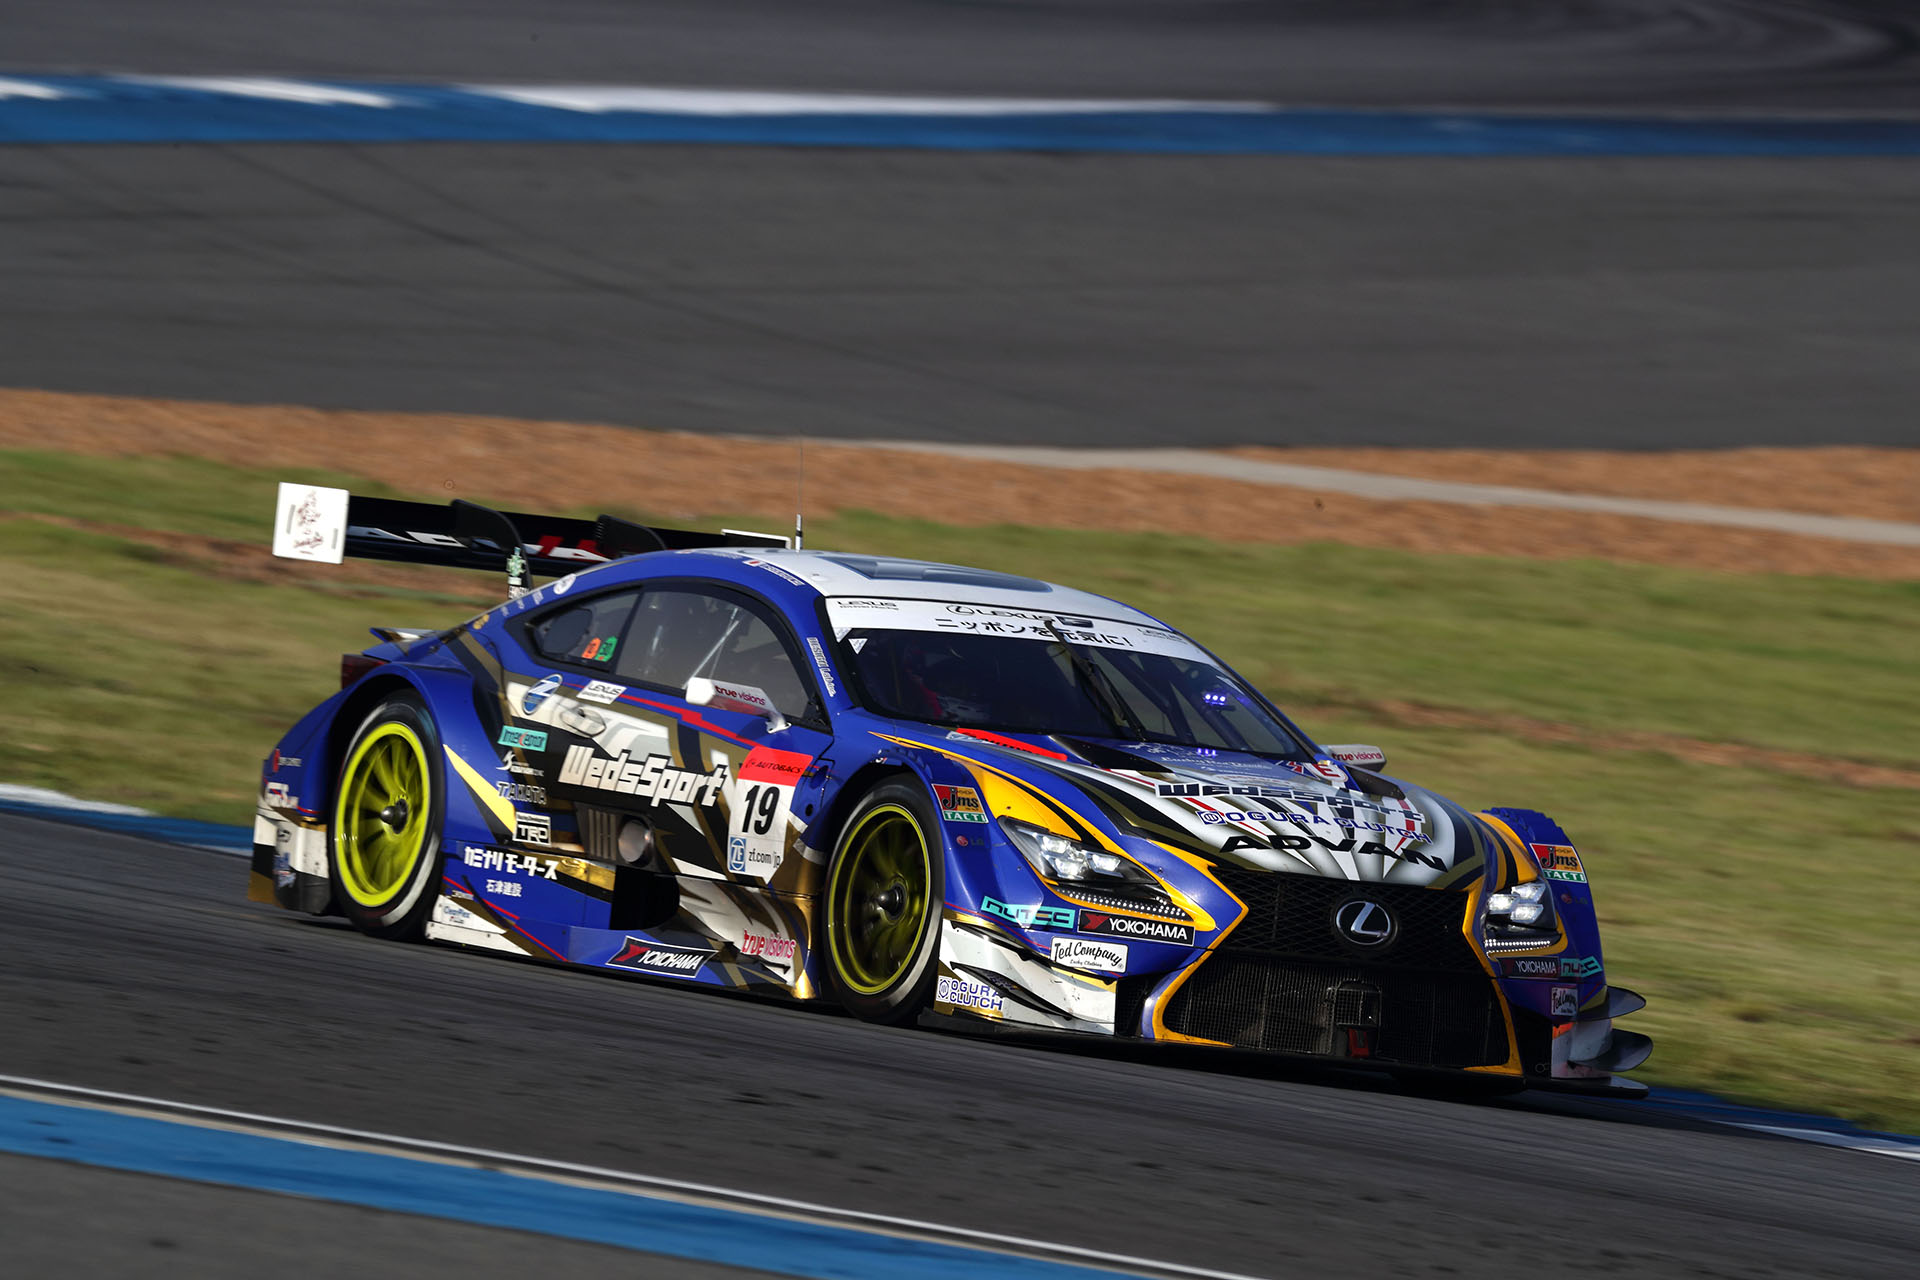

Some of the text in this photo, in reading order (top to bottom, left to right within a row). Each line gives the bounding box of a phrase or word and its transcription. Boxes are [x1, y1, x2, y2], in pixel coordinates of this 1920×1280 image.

[975, 608, 1055, 623] LEXUS
[714, 685, 766, 706] true visions
[1331, 751, 1382, 761] true visions
[557, 744, 728, 807] WedsSport
[756, 762, 804, 774] AUTOBACS
[742, 785, 781, 835] 19
[1156, 782, 1426, 824] WedsSport
[943, 811, 986, 823] TACTI
[517, 824, 549, 843] TRD
[1225, 810, 1434, 845] OGURA CLUTCH
[1218, 834, 1449, 873] ADVAN
[1545, 869, 1584, 882] TACTI
[1109, 916, 1188, 941] YOKOHAMA
[741, 929, 797, 959] true visions
[1054, 941, 1122, 967] Ted Company
[637, 950, 704, 970] YOKOHAMA
[1515, 961, 1557, 974] YOKOHAMA
[949, 991, 1003, 1011] CLUTCH
